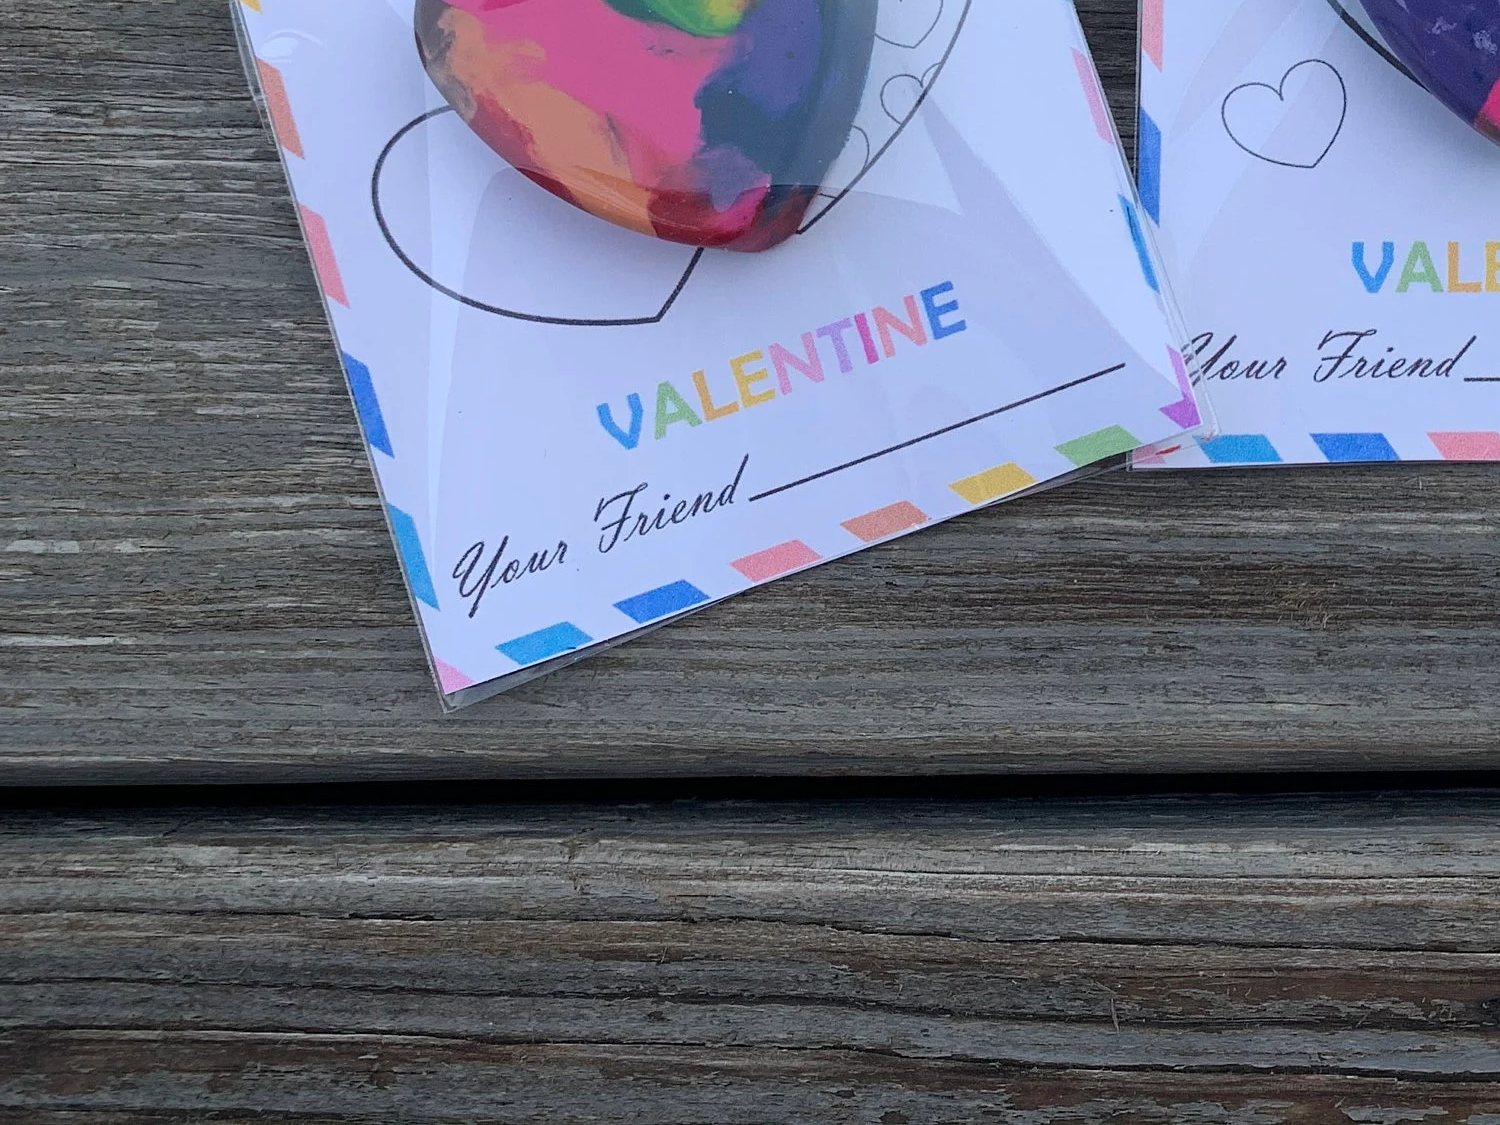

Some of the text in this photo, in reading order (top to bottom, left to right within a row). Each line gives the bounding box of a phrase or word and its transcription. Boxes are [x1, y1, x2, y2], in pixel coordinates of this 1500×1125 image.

[597, 280, 967, 450] VALENTINE
[1181, 329, 1477, 385] Your Friend
[452, 453, 749, 618] Your Friend
